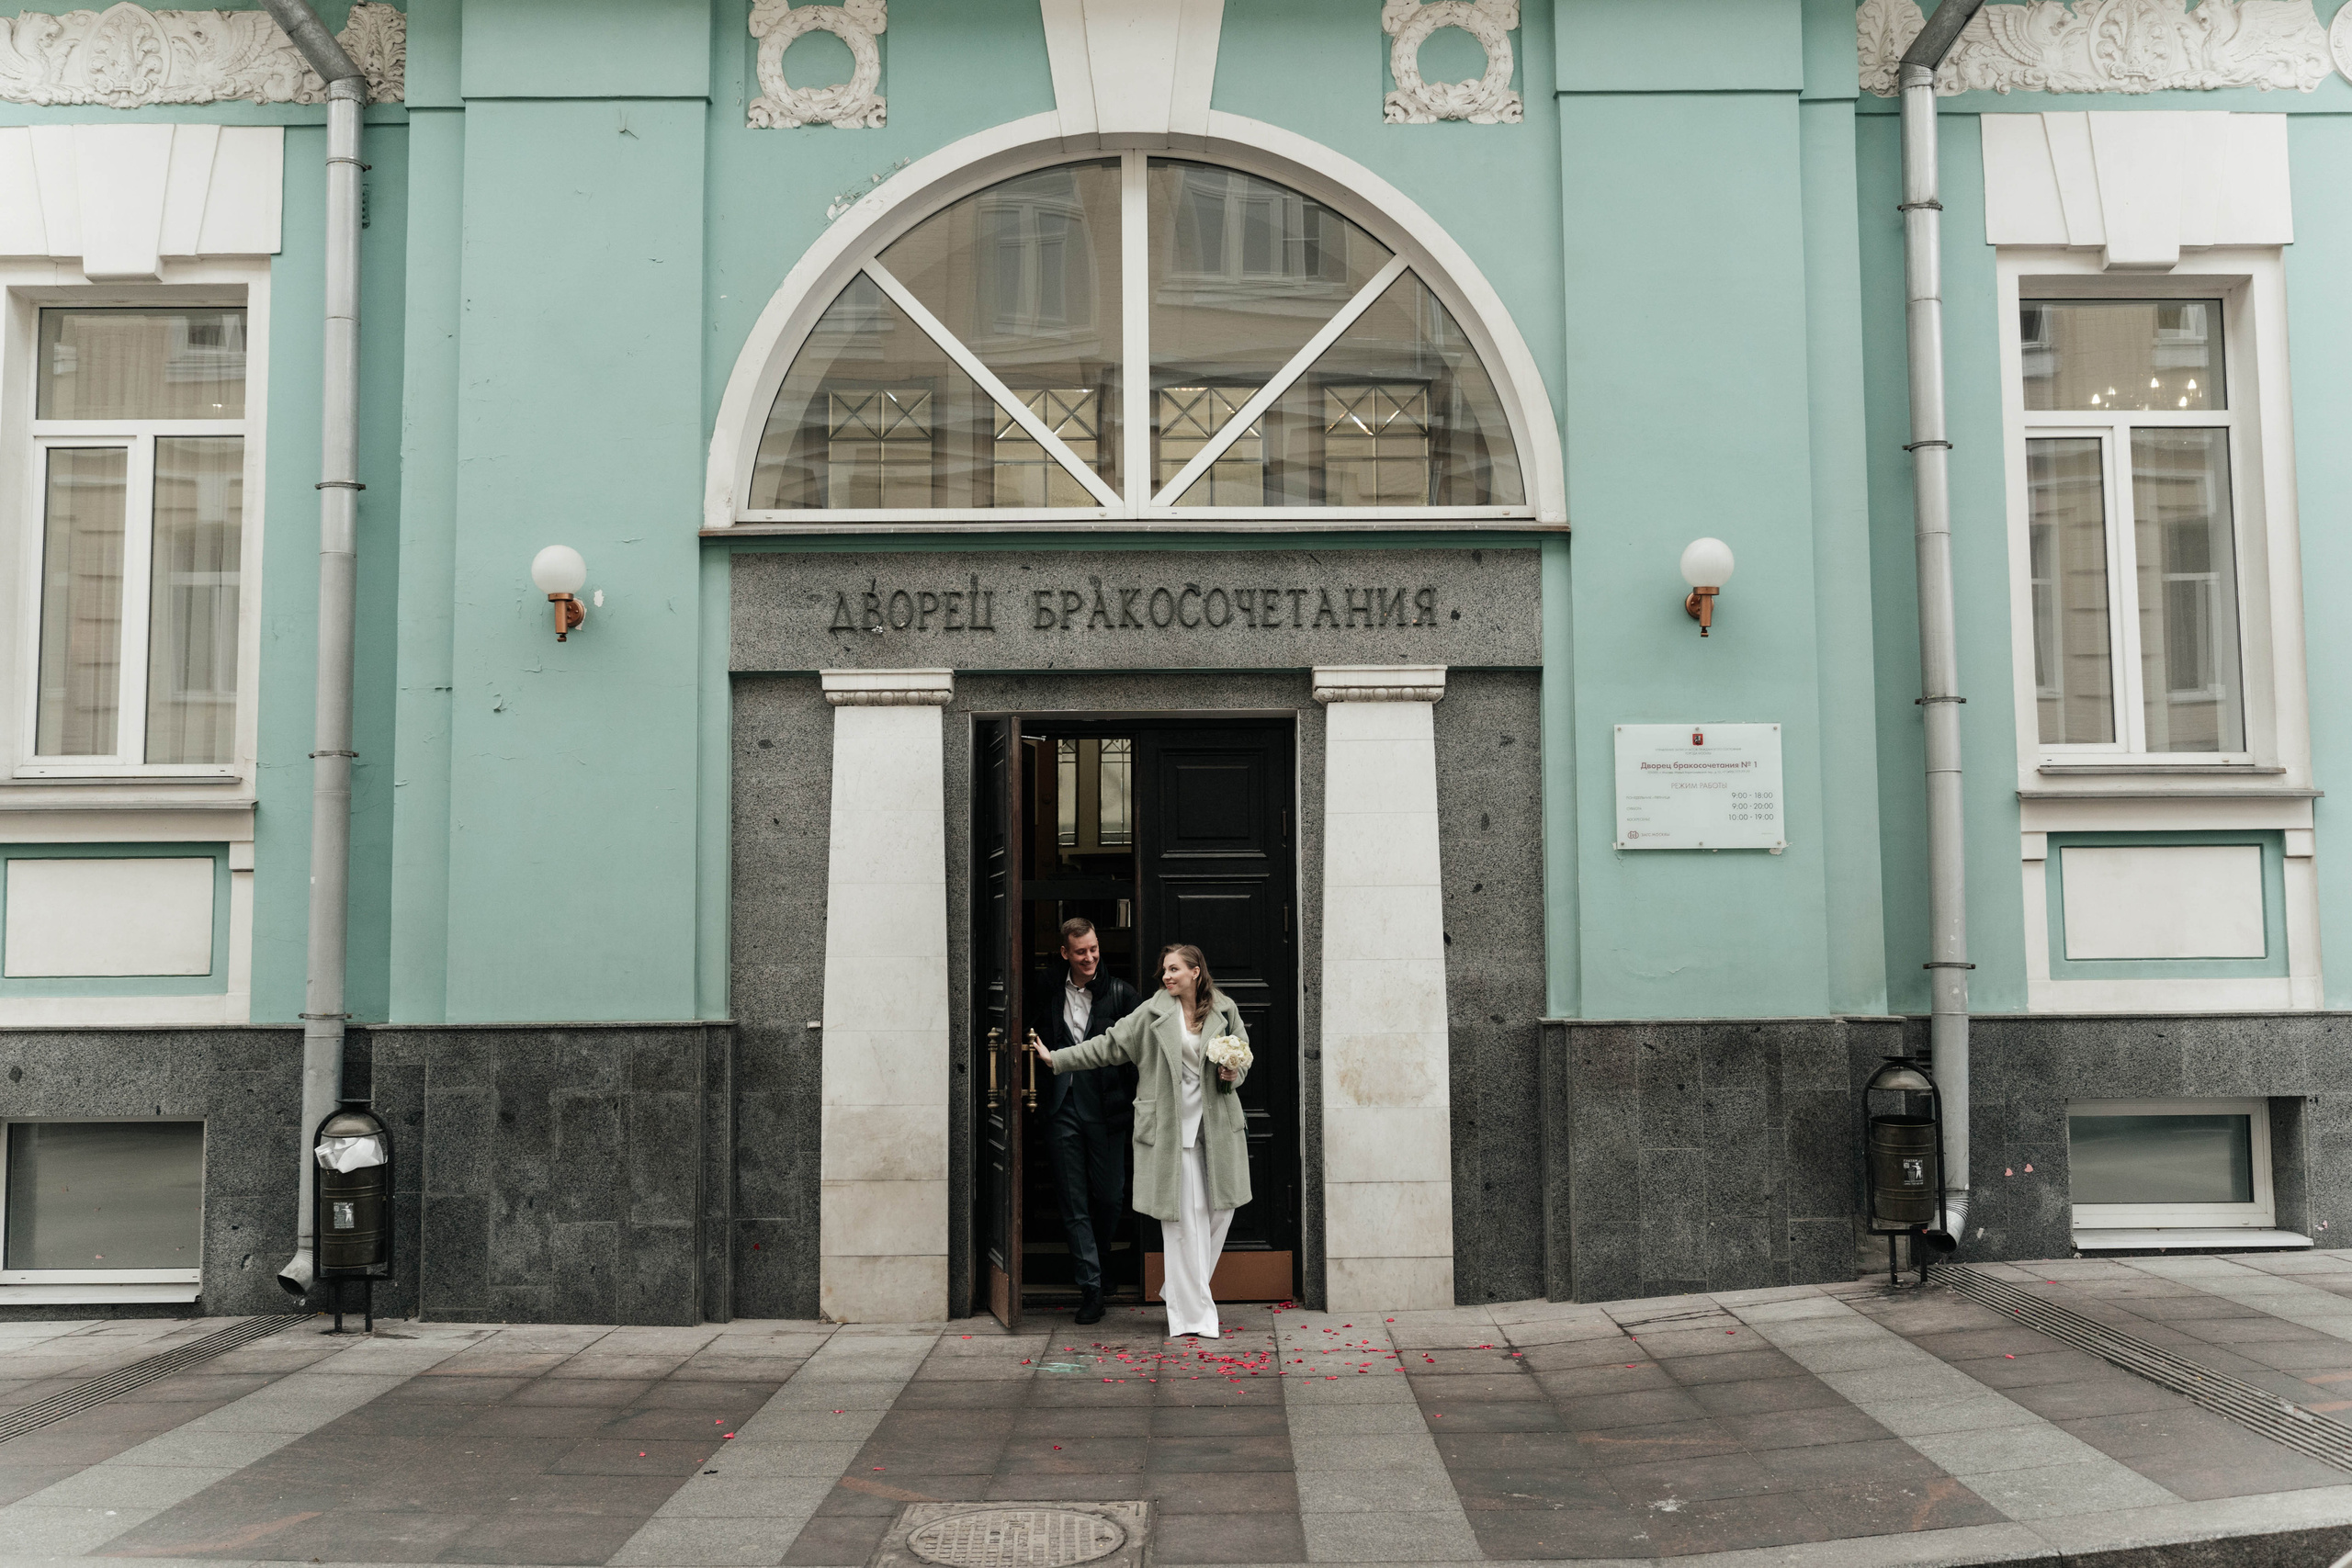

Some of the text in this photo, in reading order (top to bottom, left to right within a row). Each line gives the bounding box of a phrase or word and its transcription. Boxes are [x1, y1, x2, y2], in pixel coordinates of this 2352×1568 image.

[828, 588, 1437, 632] ДВОРЕЦ БРАКОСОЧЕТАНИЯ
[1640, 761, 1671, 770] Дворец
[1673, 761, 1739, 770] бракосочетания
